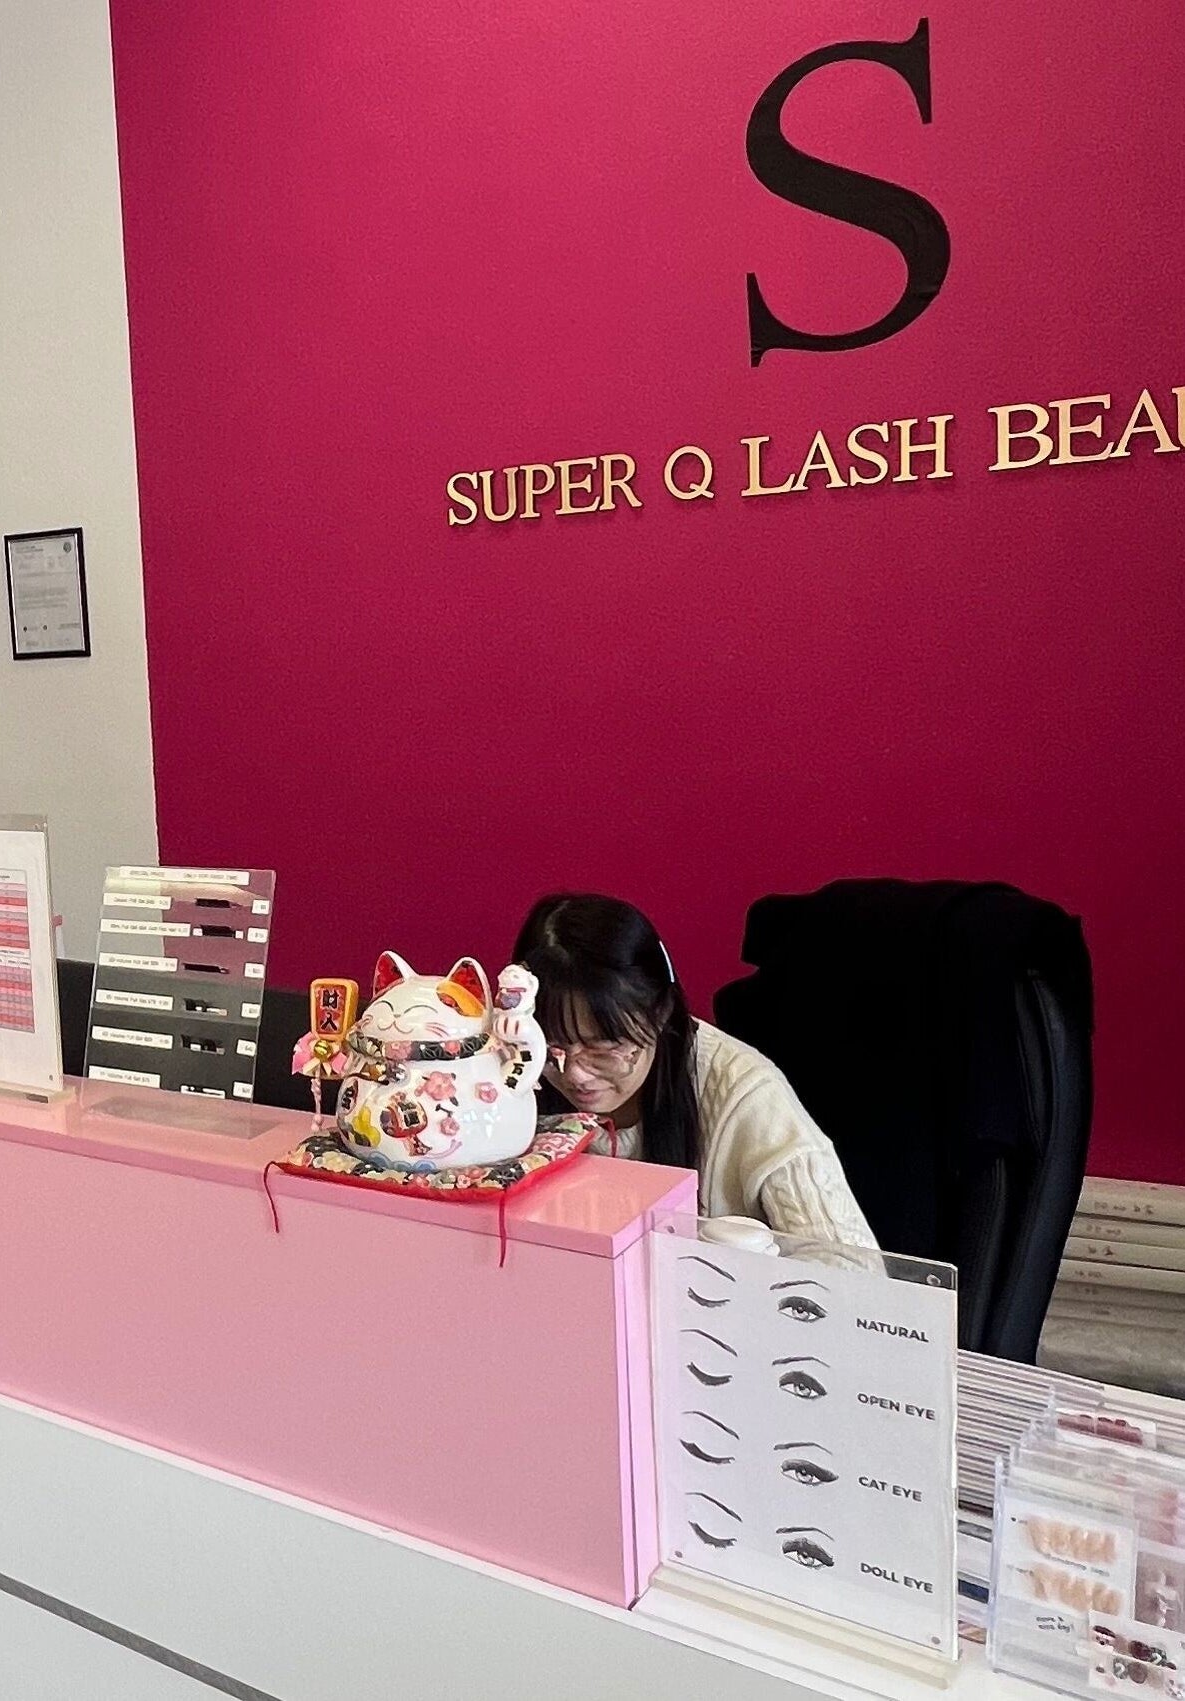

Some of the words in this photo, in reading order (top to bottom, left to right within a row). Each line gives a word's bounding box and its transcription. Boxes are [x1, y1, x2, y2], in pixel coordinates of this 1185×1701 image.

[745, 17, 951, 368] S
[446, 453, 643, 527] SUPER
[663, 444, 714, 500] Q
[740, 414, 955, 498] LASH
[988, 387, 1185, 473] BEA
[856, 1318, 930, 1343] NATURAL
[857, 1393, 901, 1413] OPEN
[905, 1404, 936, 1421] EYE
[858, 1476, 888, 1492] CAT
[892, 1485, 923, 1503] EYE
[860, 1562, 900, 1584] DOLL
[903, 1576, 934, 1594] EYE
